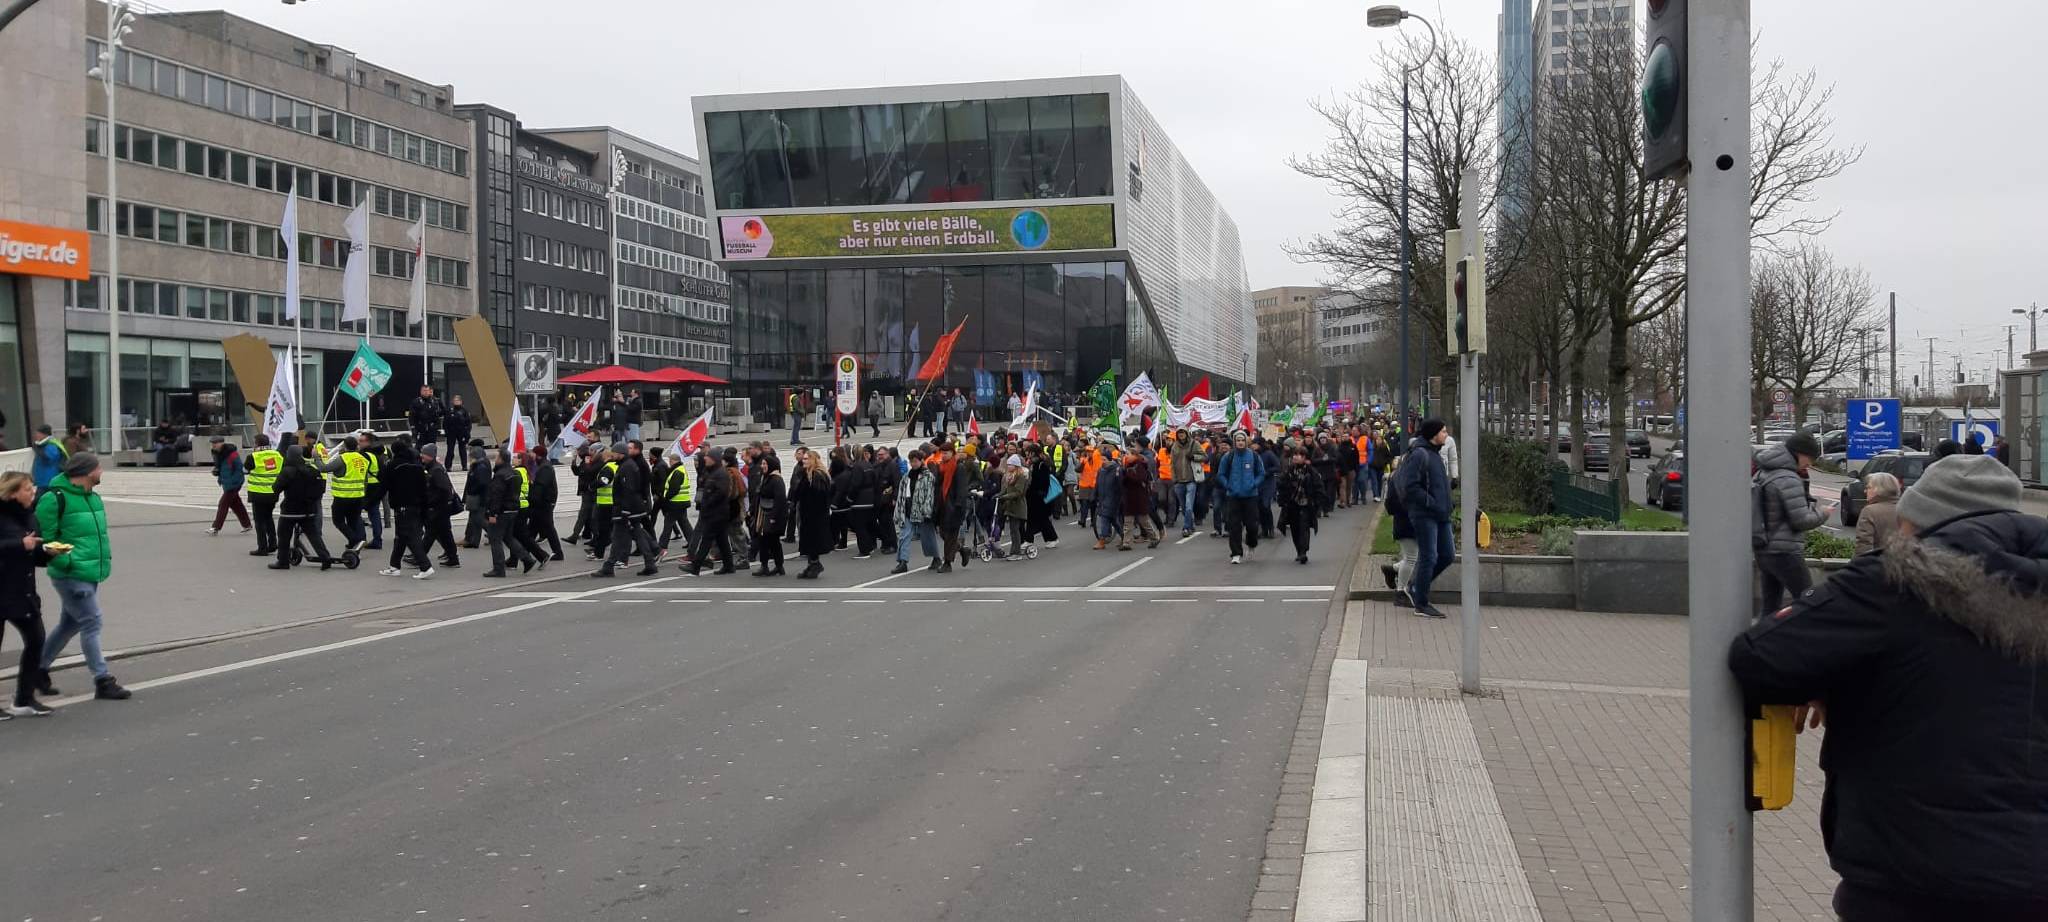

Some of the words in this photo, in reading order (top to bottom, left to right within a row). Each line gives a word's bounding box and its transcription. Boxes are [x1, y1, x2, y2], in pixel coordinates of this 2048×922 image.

[853, 219, 869, 232] Es
[873, 218, 900, 235] gibt
[904, 217, 938, 230] viele
[942, 216, 982, 231] Bälle,
[839, 234, 869, 248] aber
[873, 236, 897, 247] nur
[901, 233, 940, 246] einen
[944, 230, 1000, 245] Erdball.
[1865, 402, 1883, 424] P
